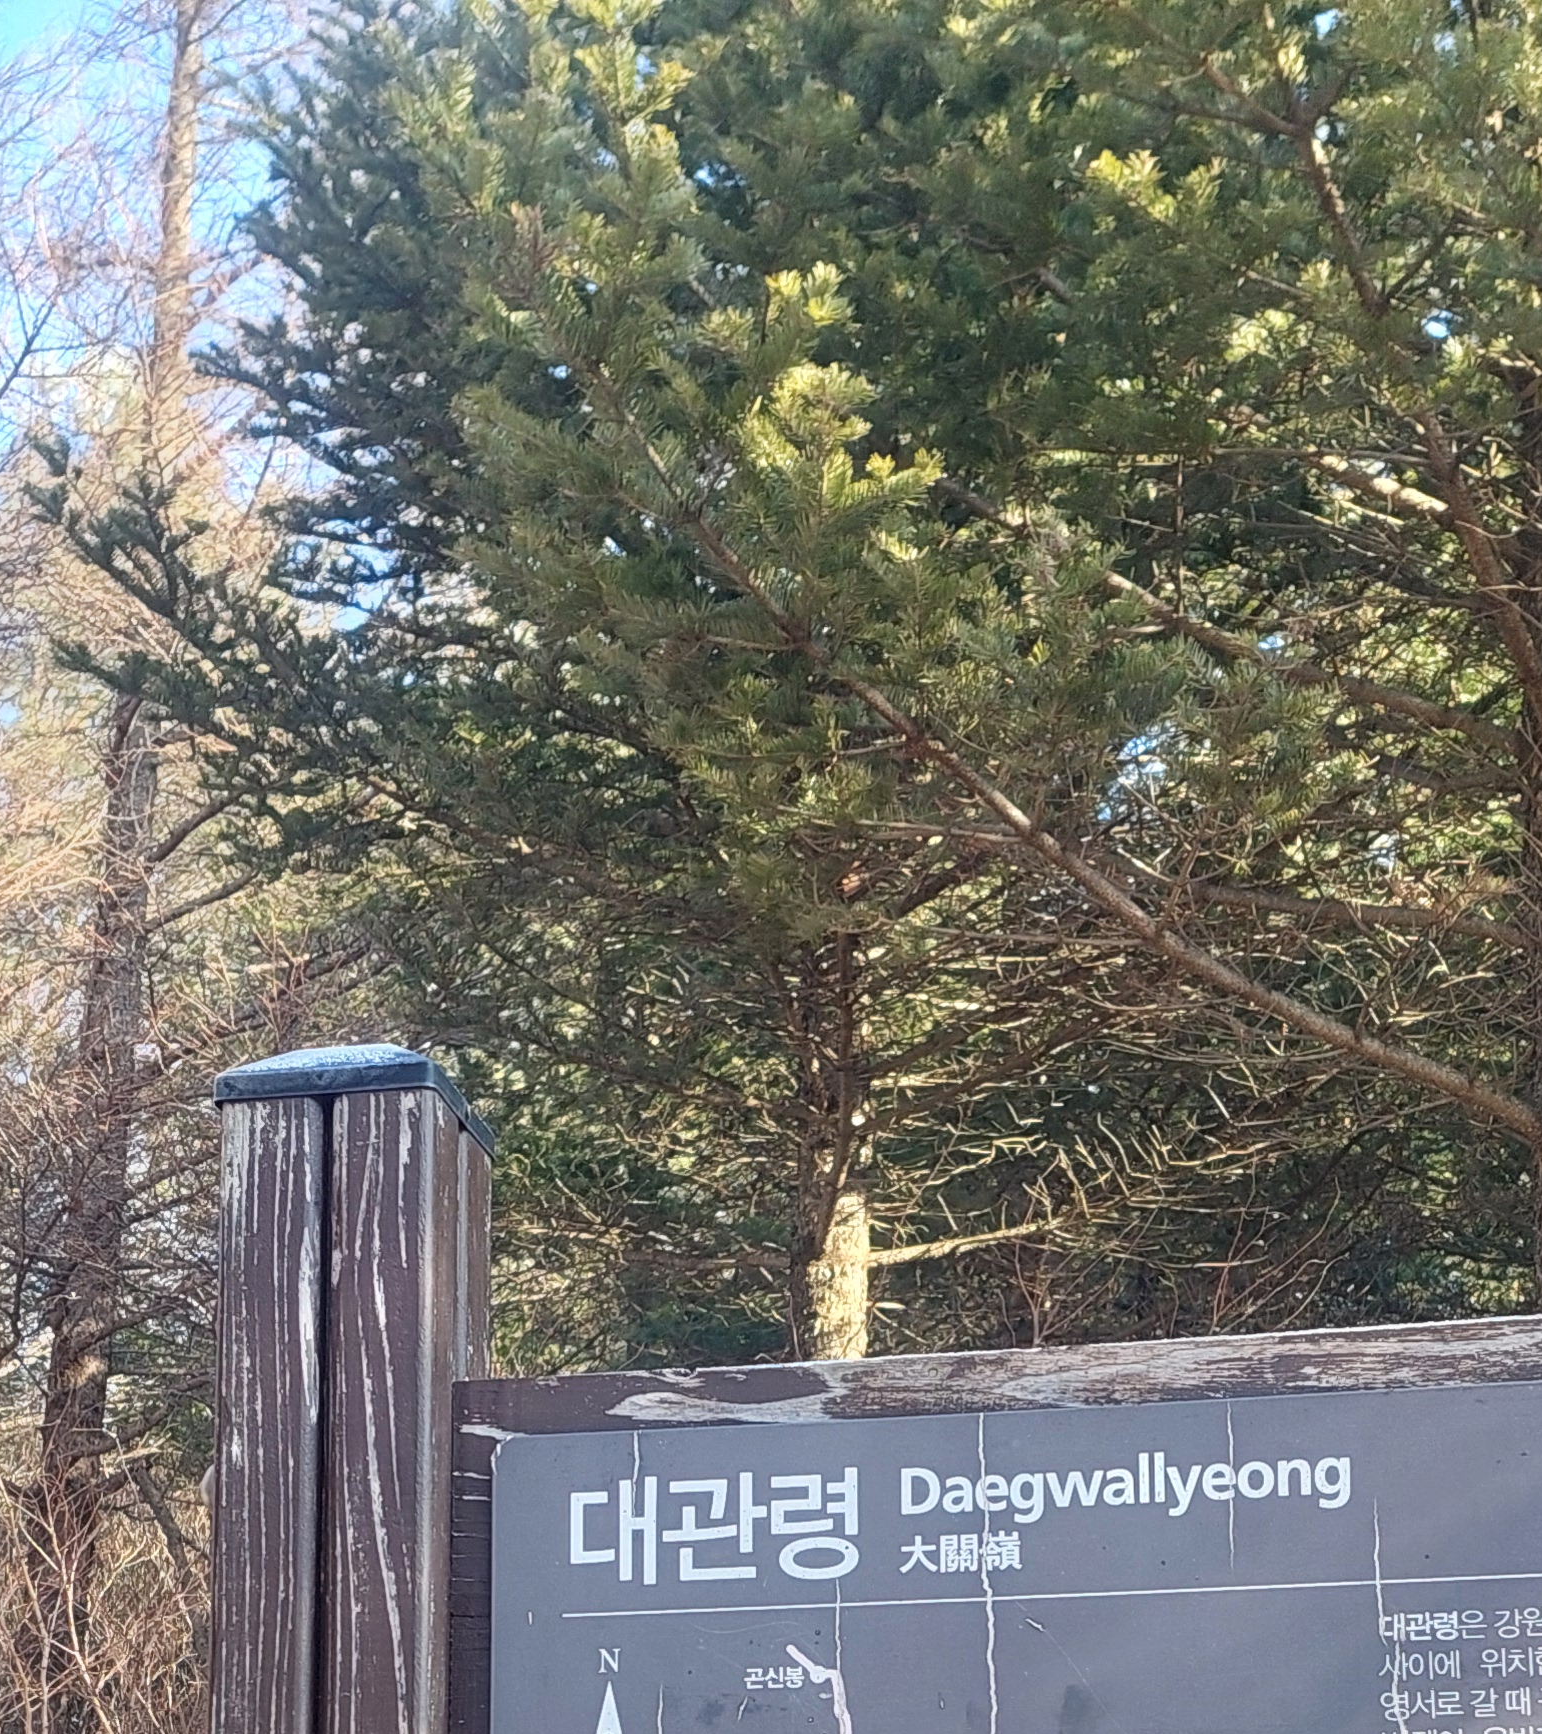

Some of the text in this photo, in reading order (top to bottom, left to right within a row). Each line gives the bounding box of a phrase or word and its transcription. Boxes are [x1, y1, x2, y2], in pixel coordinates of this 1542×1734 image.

[569, 1453, 1352, 1584] 대관령 Daegwallyeong
[899, 1530, 1023, 1576] 大關嶺
[1382, 1610, 1487, 1642] 대관령은
[598, 1649, 620, 1674] N
[744, 1666, 804, 1689] 곤신봉
[1378, 1649, 1461, 1681] 사이에
